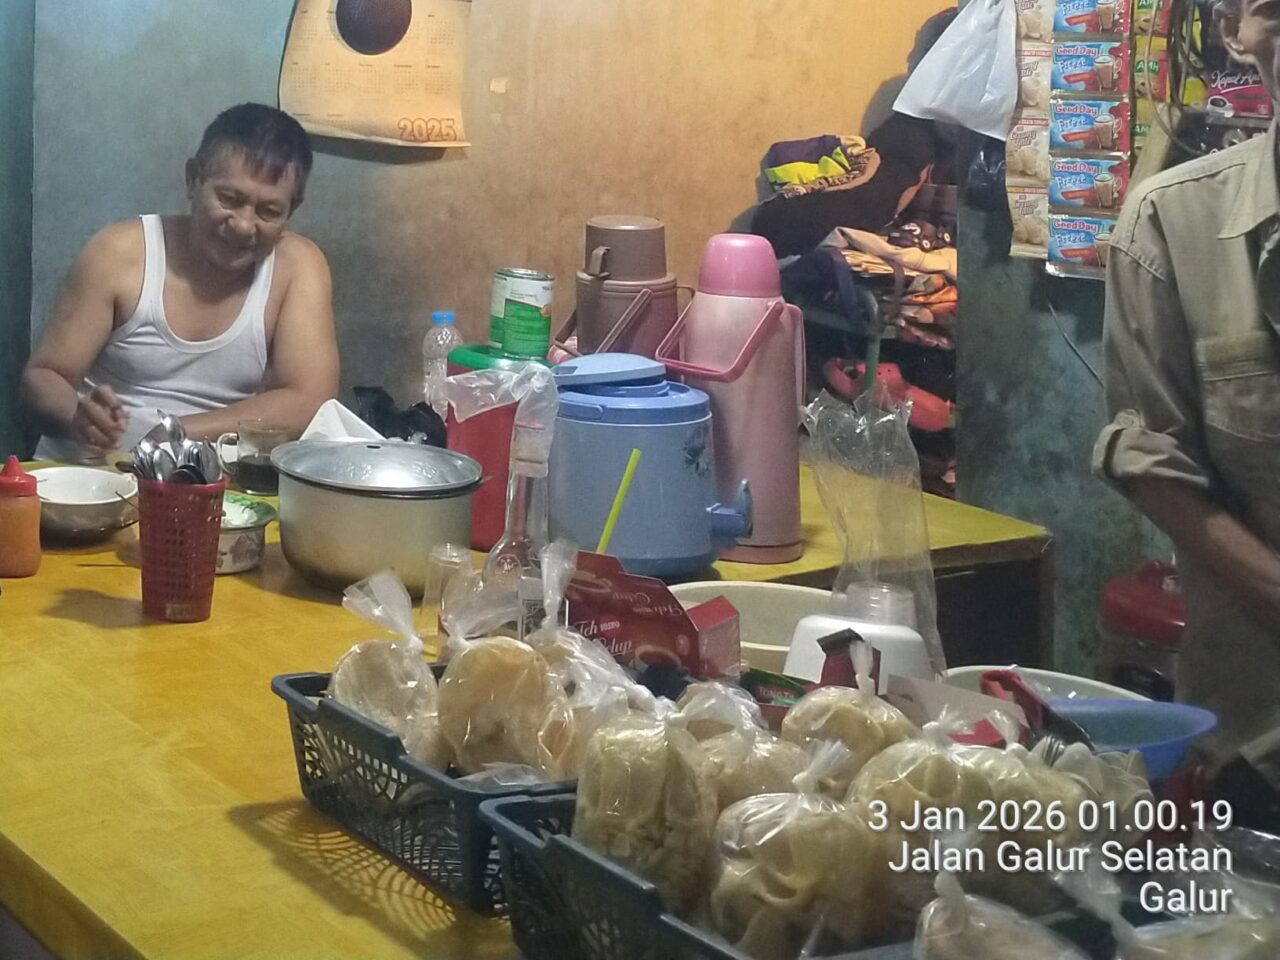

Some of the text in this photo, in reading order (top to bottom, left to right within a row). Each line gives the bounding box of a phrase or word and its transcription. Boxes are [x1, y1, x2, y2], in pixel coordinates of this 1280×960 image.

[1056, 46, 1078, 55] Good
[1079, 46, 1097, 56] Day
[1055, 104, 1097, 115] Good Day
[397, 117, 457, 142] 2025
[1053, 161, 1097, 174] Good Day
[1053, 220, 1097, 233] Good Day
